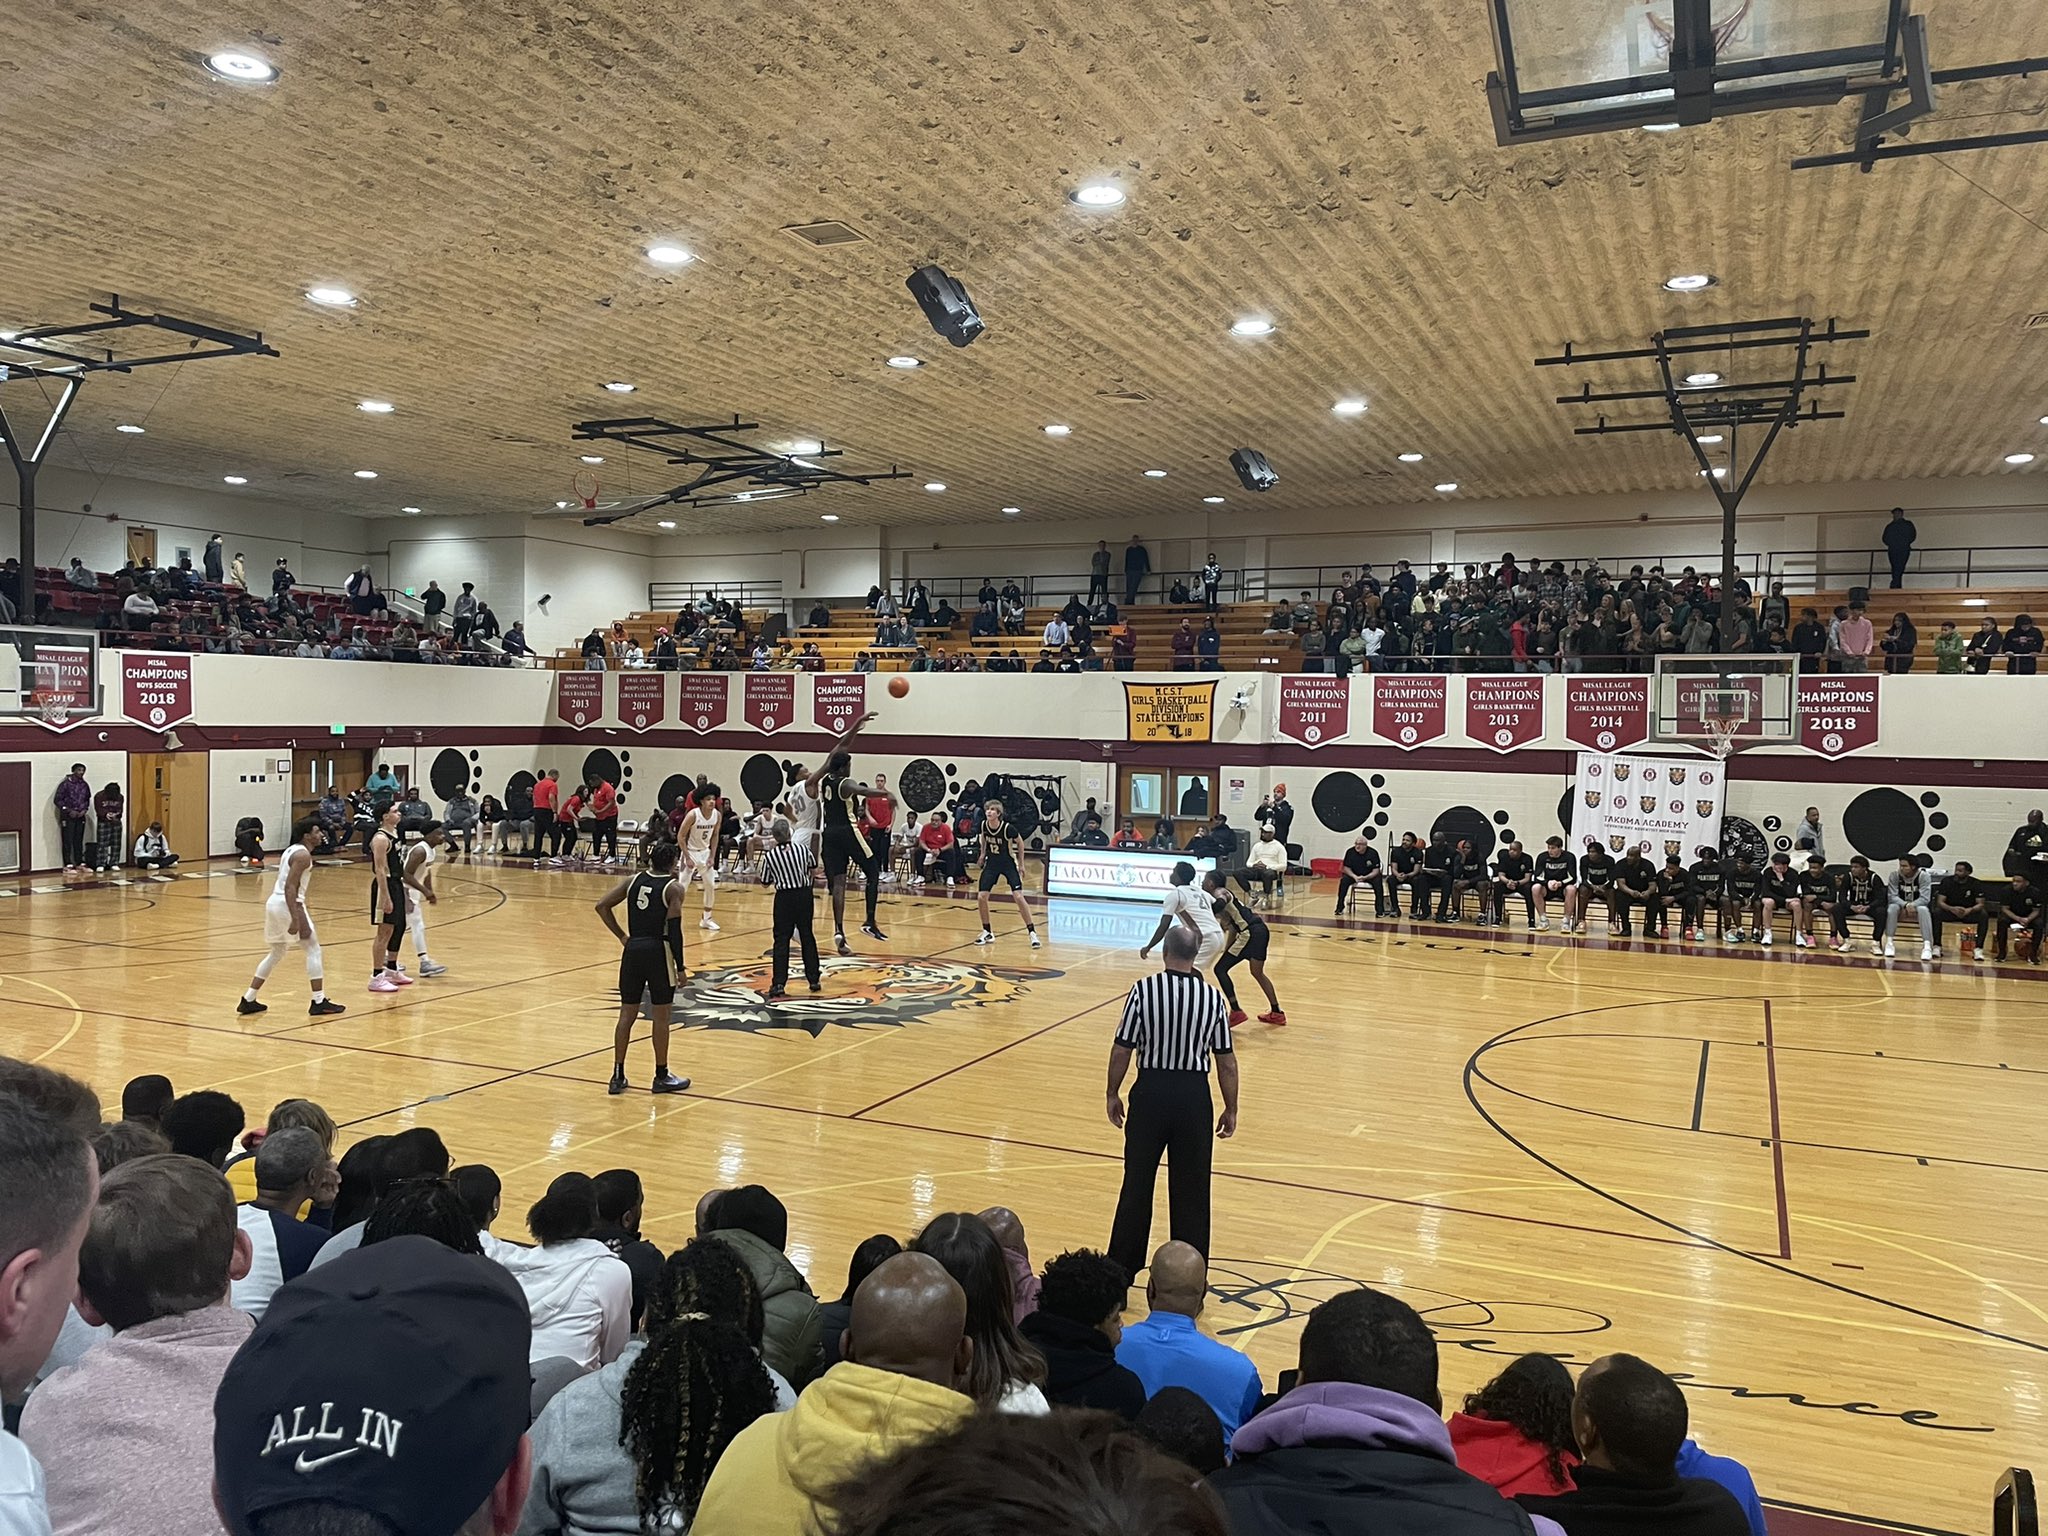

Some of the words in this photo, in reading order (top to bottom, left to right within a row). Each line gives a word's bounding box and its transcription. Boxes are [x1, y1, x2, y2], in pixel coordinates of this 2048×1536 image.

[126, 668, 188, 680] CHAMPIONS
[817, 686, 863, 694] CHAMPIONS
[1284, 689, 1346, 699] CHAMPIONS
[1377, 688, 1443, 699] CHAMPIONS
[1470, 690, 1540, 700] CHAMPIONS
[140, 693, 176, 704] 2018
[1132, 696, 1154, 704] GIRLS
[1157, 695, 1208, 705] BASKETBALL
[1570, 691, 1644, 701] CHAMPIONS
[571, 699, 589, 708] 2013
[632, 701, 650, 710] 2014
[694, 702, 713, 711] 2015
[760, 702, 779, 712] 2017
[1152, 705, 1183, 713] DIVISION
[1186, 704, 1189, 713] I
[826, 705, 852, 715] 2018
[1136, 713, 1160, 722] STATE
[1162, 713, 1205, 722] CHAMPIONS
[1300, 711, 1326, 723] 2011
[1394, 711, 1424, 723] 2012
[1489, 714, 1519, 725] 2013
[1590, 716, 1623, 728] 2014
[1810, 718, 1856, 730] 2018
[1147, 728, 1156, 736] 20
[1185, 728, 1192, 736] 18
[1604, 816, 1640, 826] TAKOMA
[1642, 819, 1689, 829] ACADEMY
[702, 831, 709, 840] 5
[1052, 864, 1116, 881] TAKOMA
[637, 886, 652, 910] 5
[260, 1402, 343, 1456] ALL
[355, 1407, 403, 1458] IN
